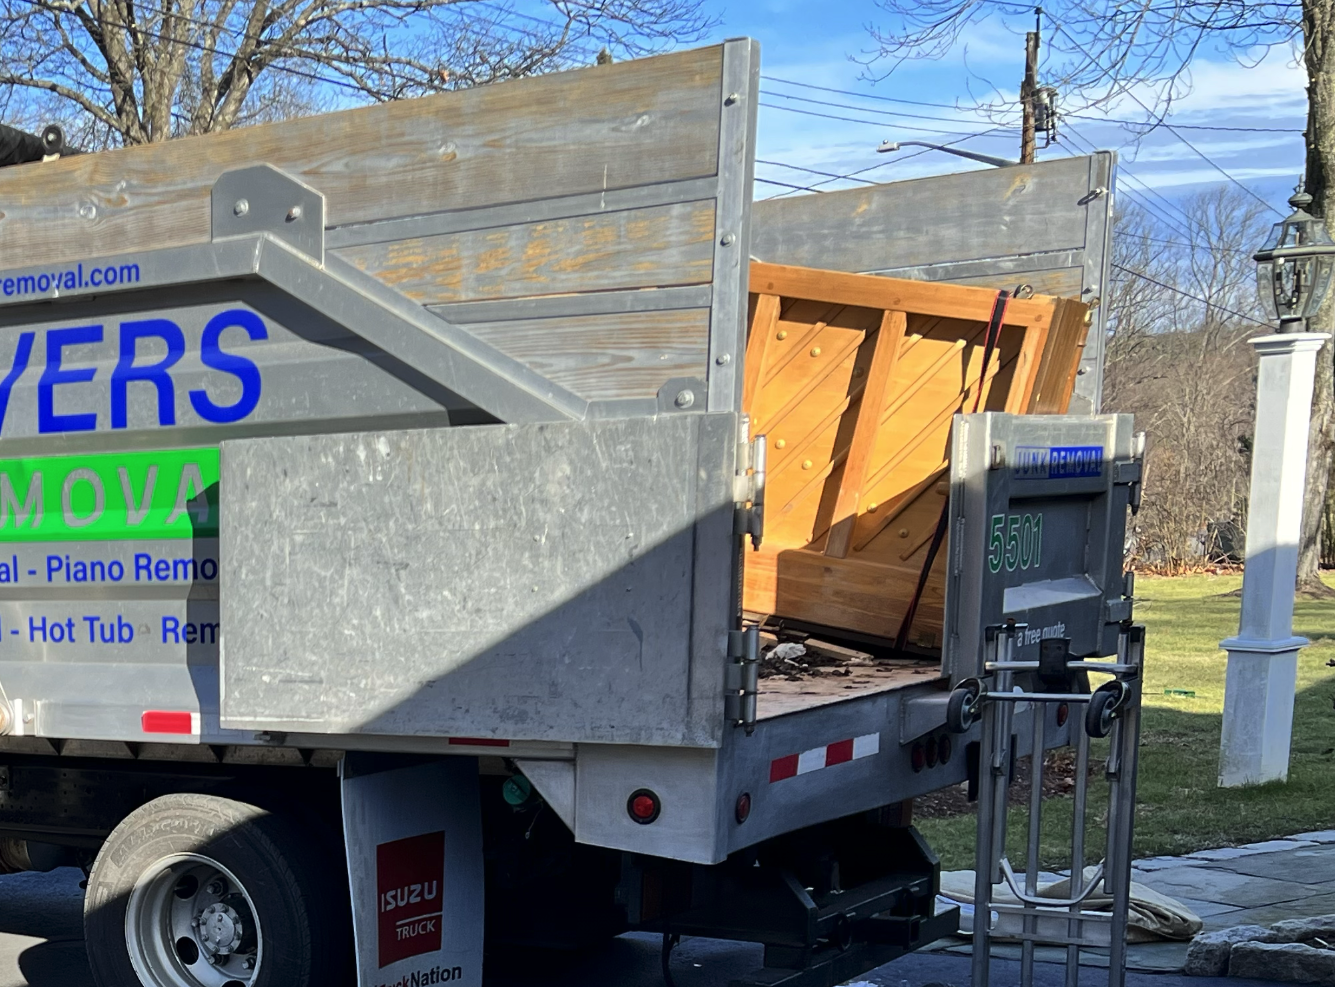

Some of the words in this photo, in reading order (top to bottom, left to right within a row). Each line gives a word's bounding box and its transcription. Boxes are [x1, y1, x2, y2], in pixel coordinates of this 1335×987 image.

[1014, 450, 1048, 474] JUNK
[1051, 449, 1102, 474] REMOVAL
[988, 512, 1043, 574] 5501
[45, 553, 125, 583] Piano
[133, 551, 219, 582] Remo
[28, 615, 76, 643] Hot
[82, 613, 135, 644] Tub
[160, 615, 220, 644] Rem
[1017, 632, 1023, 647] a
[1025, 626, 1041, 646] free
[381, 880, 438, 913] ISUZU
[395, 919, 437, 941] TRUCK
